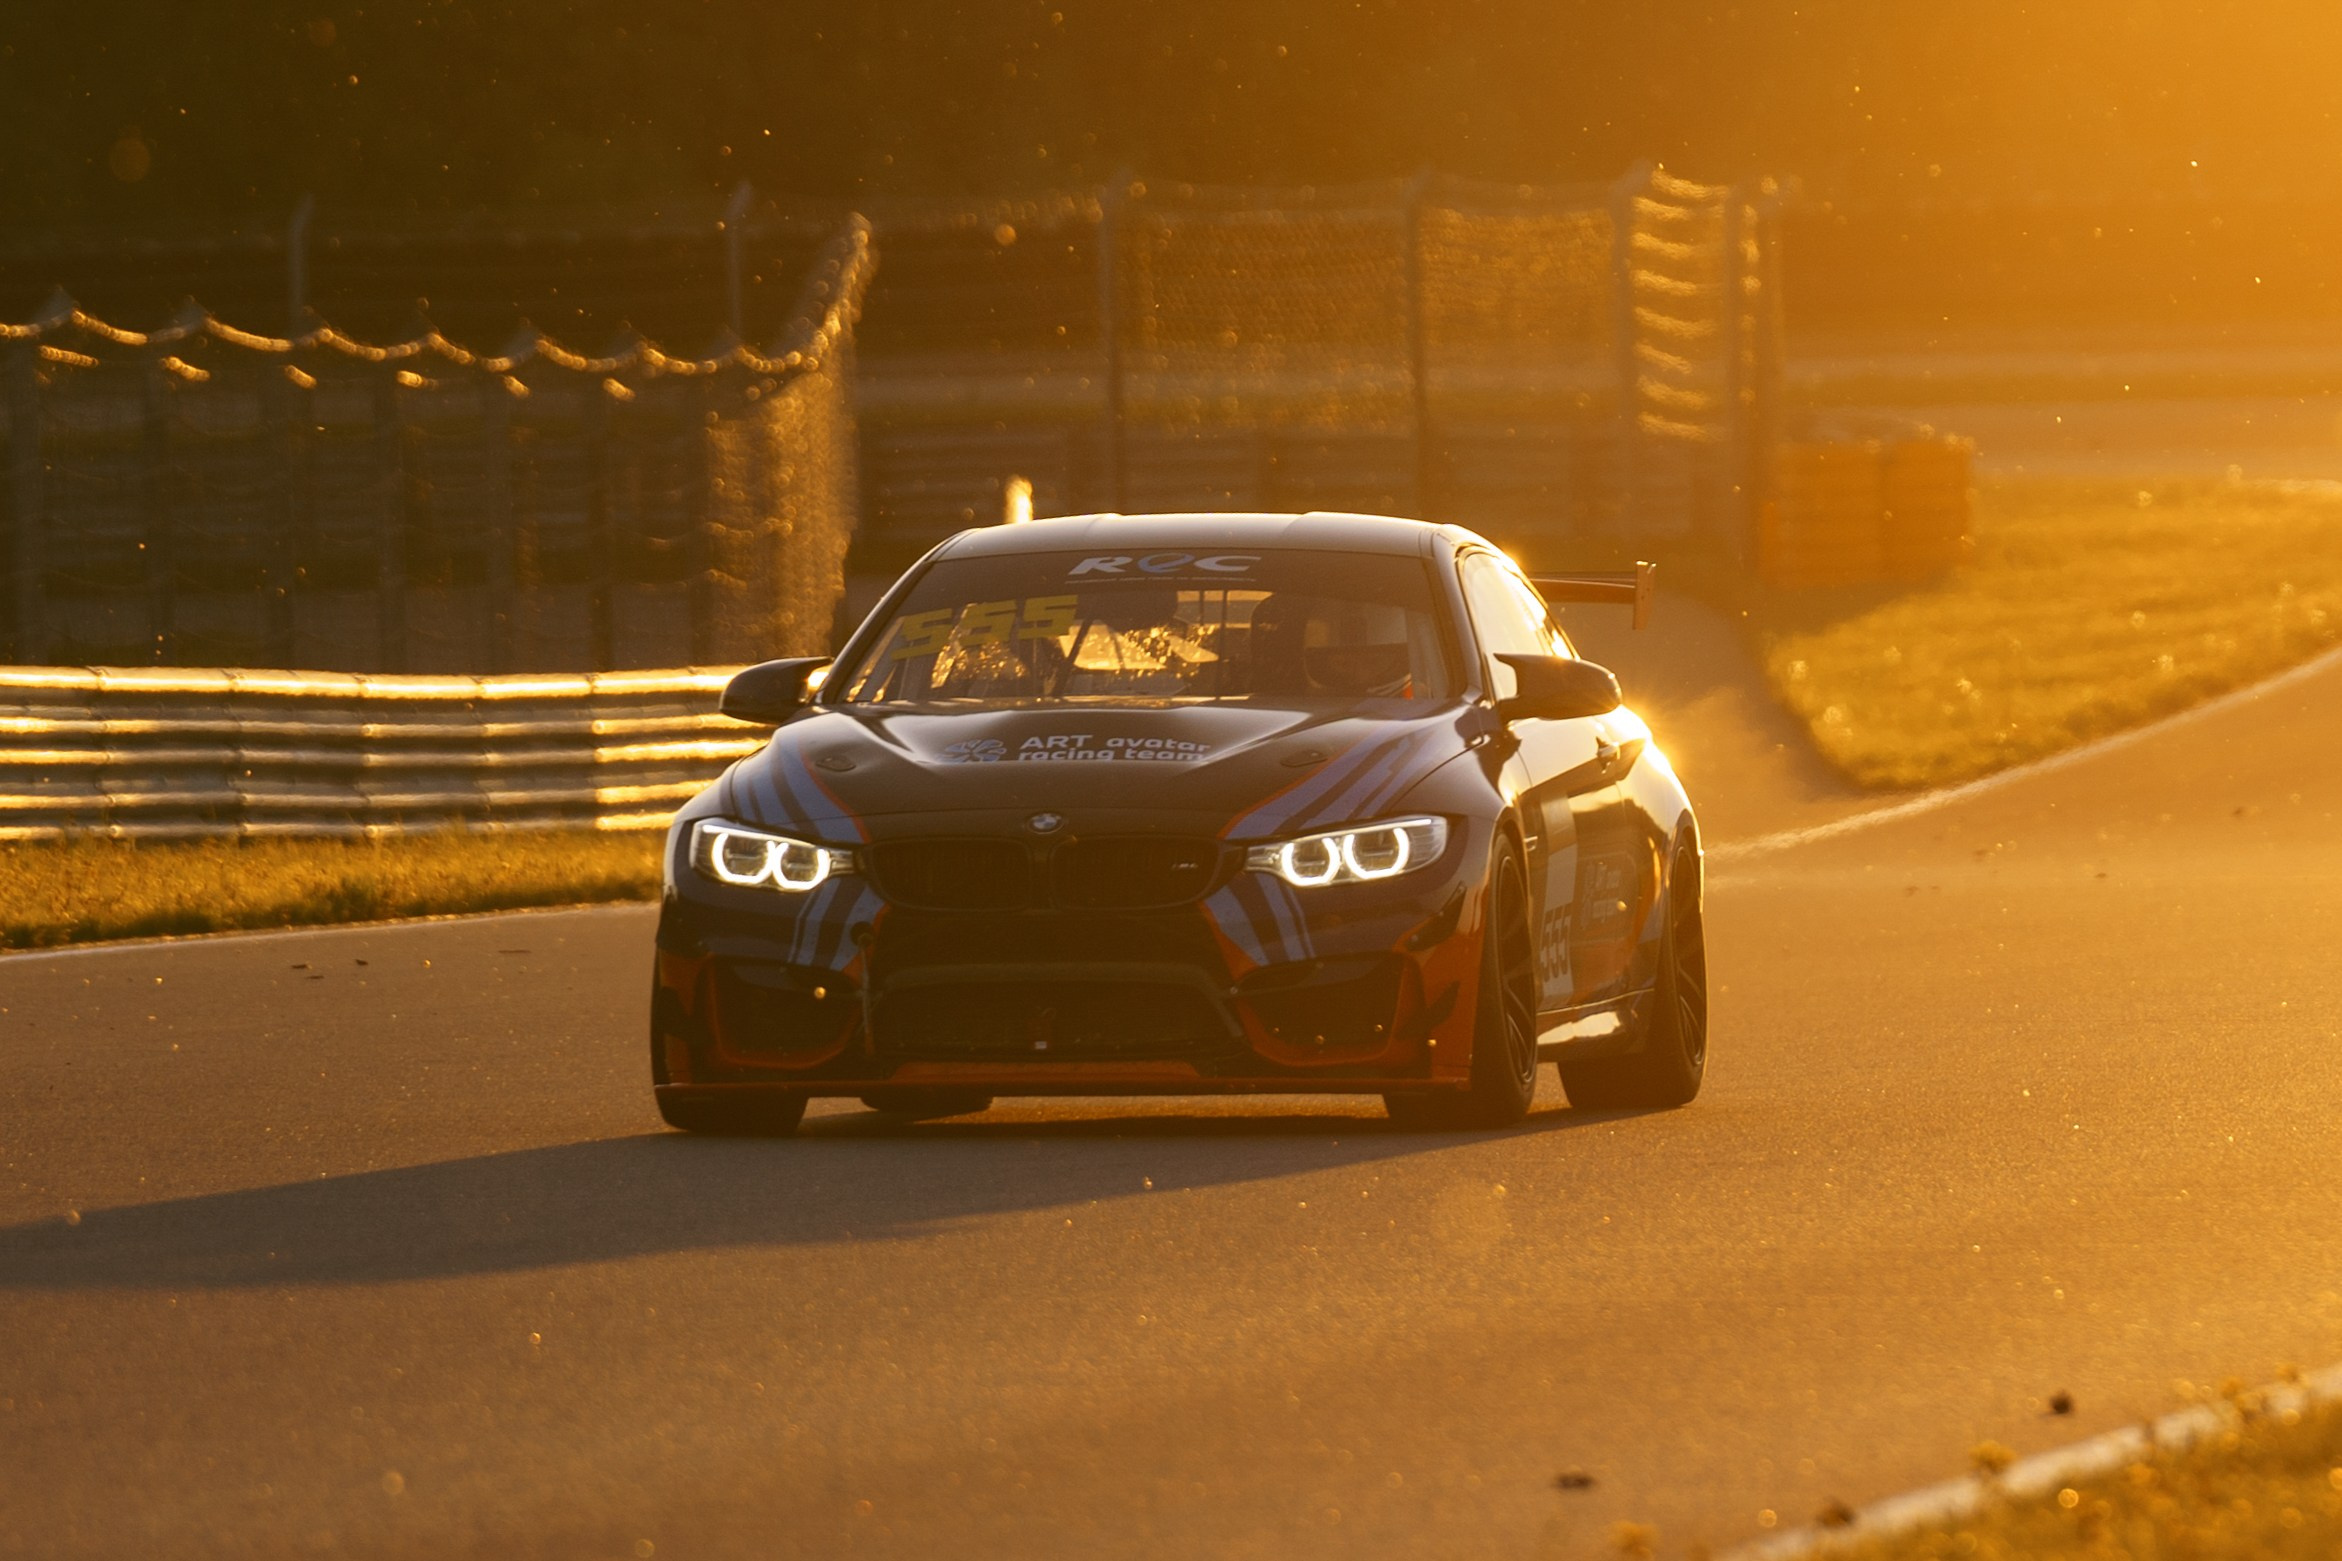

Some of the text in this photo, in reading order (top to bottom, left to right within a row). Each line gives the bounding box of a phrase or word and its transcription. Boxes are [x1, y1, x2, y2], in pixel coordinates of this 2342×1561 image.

[1020, 735, 1211, 751] ART avatar
[1018, 747, 1206, 761] racing team
